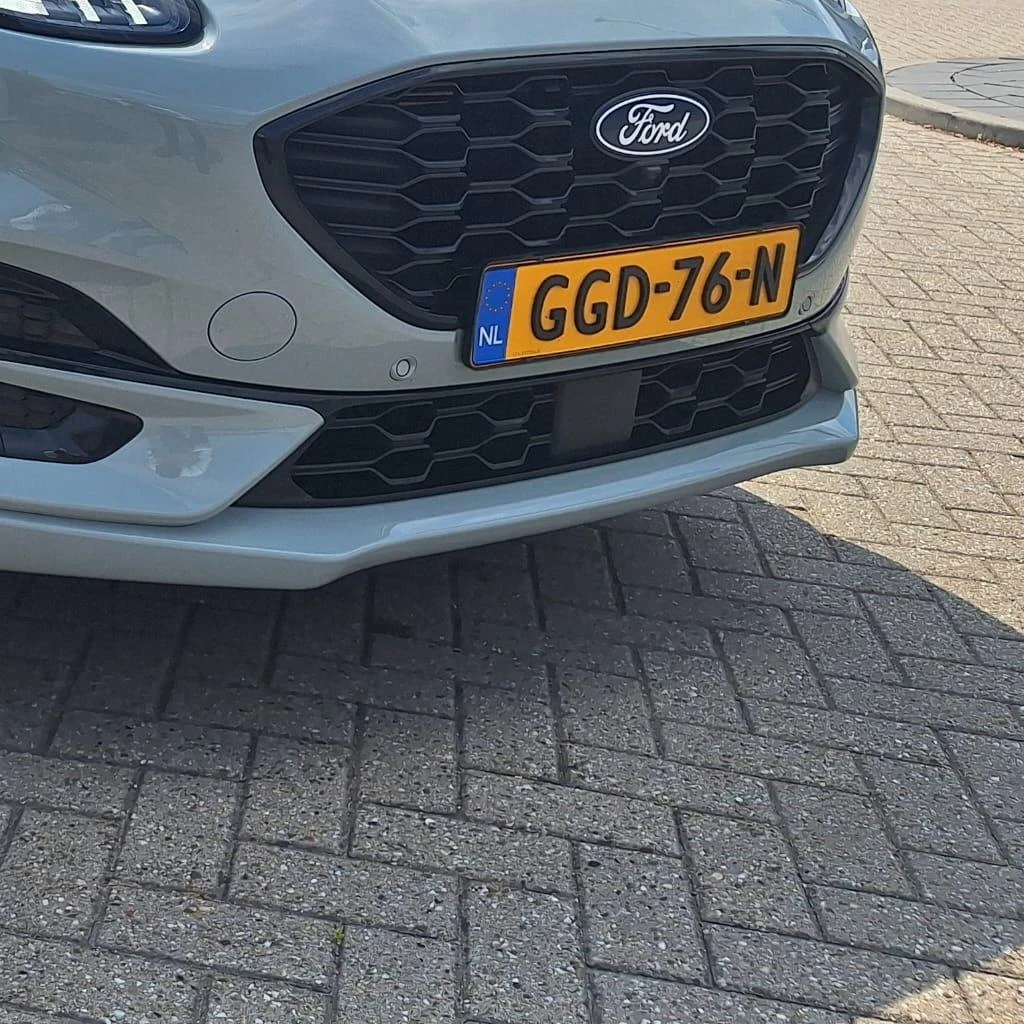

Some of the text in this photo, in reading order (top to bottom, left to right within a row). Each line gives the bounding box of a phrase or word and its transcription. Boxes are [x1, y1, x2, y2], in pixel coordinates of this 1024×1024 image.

[618, 102, 691, 146] Ford
[477, 243, 787, 347] NL GGD-76-N
